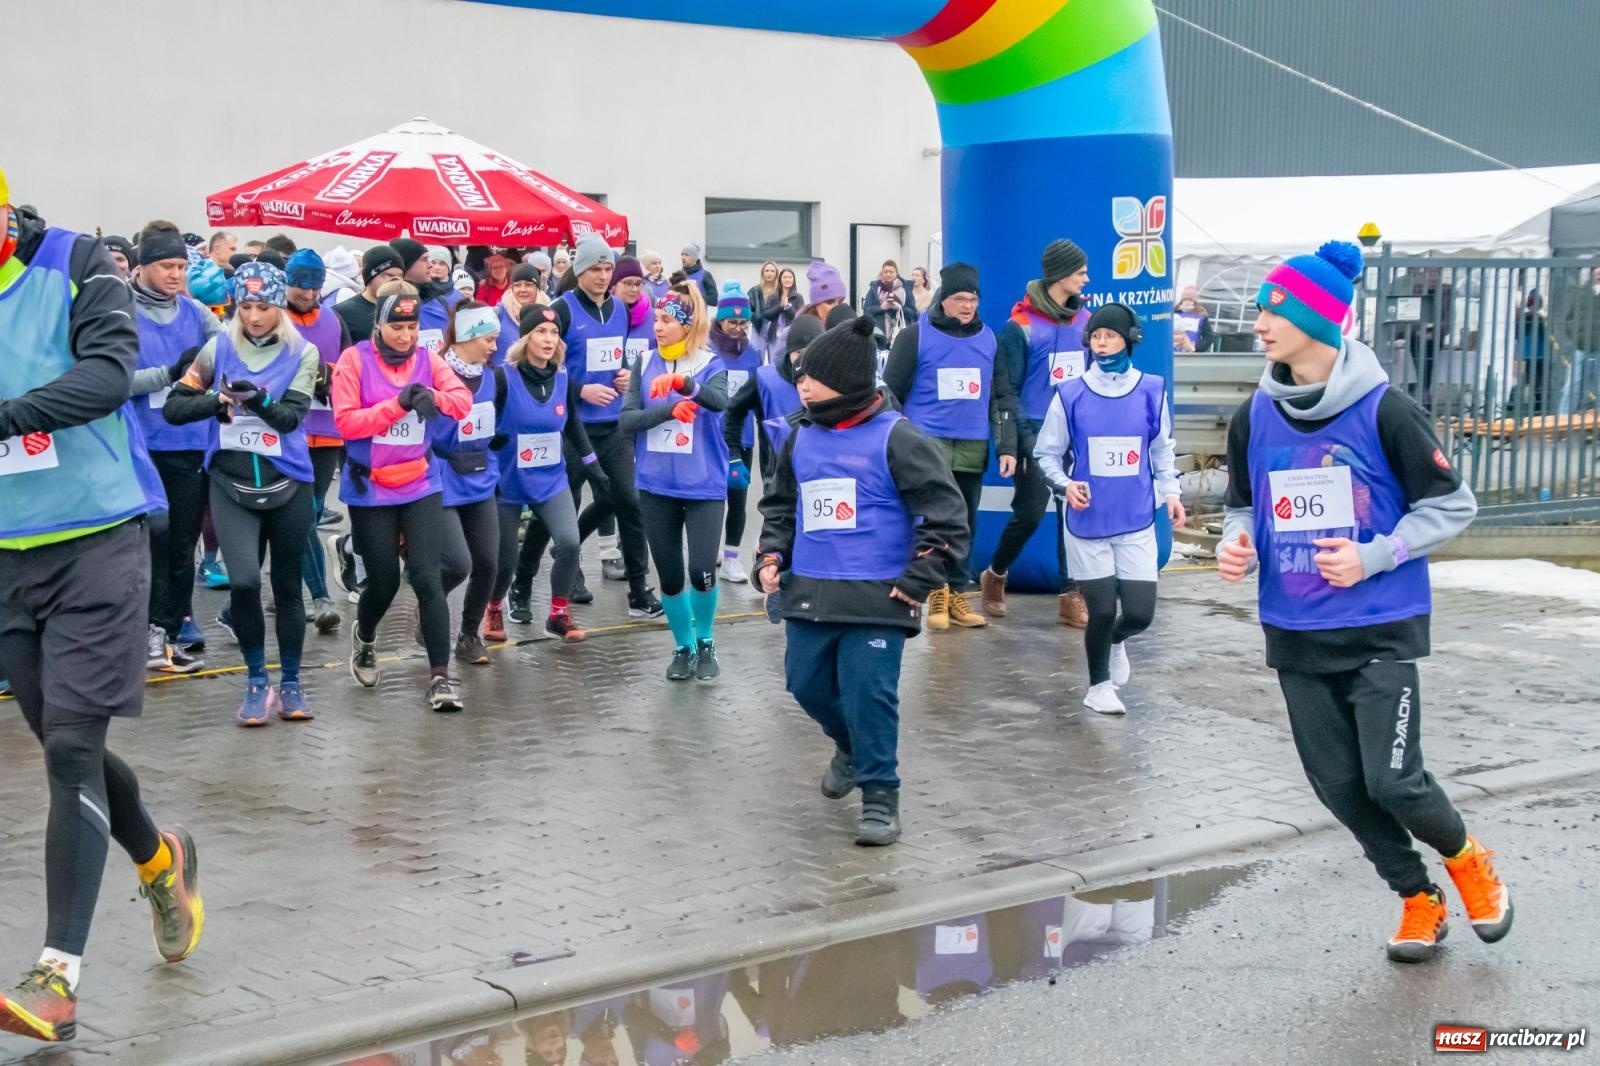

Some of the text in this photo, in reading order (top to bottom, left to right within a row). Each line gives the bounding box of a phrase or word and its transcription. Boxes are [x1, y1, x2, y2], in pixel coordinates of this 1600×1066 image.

[325, 154, 393, 199] WARKA
[437, 156, 488, 207] WARKA
[262, 201, 300, 216] WARKA
[335, 209, 381, 227] Classic
[417, 220, 466, 233] WARKA
[501, 219, 545, 237] Classic
[1119, 286, 1173, 306] KRZYŻANO
[600, 350, 612, 363] 21
[1066, 364, 1074, 377] 2
[956, 379, 965, 391] 3
[240, 431, 260, 446] 67
[390, 423, 409, 438] 68
[663, 429, 673, 443] 7
[533, 446, 548, 460] 72
[1105, 451, 1123, 467] 31
[813, 498, 834, 518] 95
[1293, 494, 1325, 519] 96
